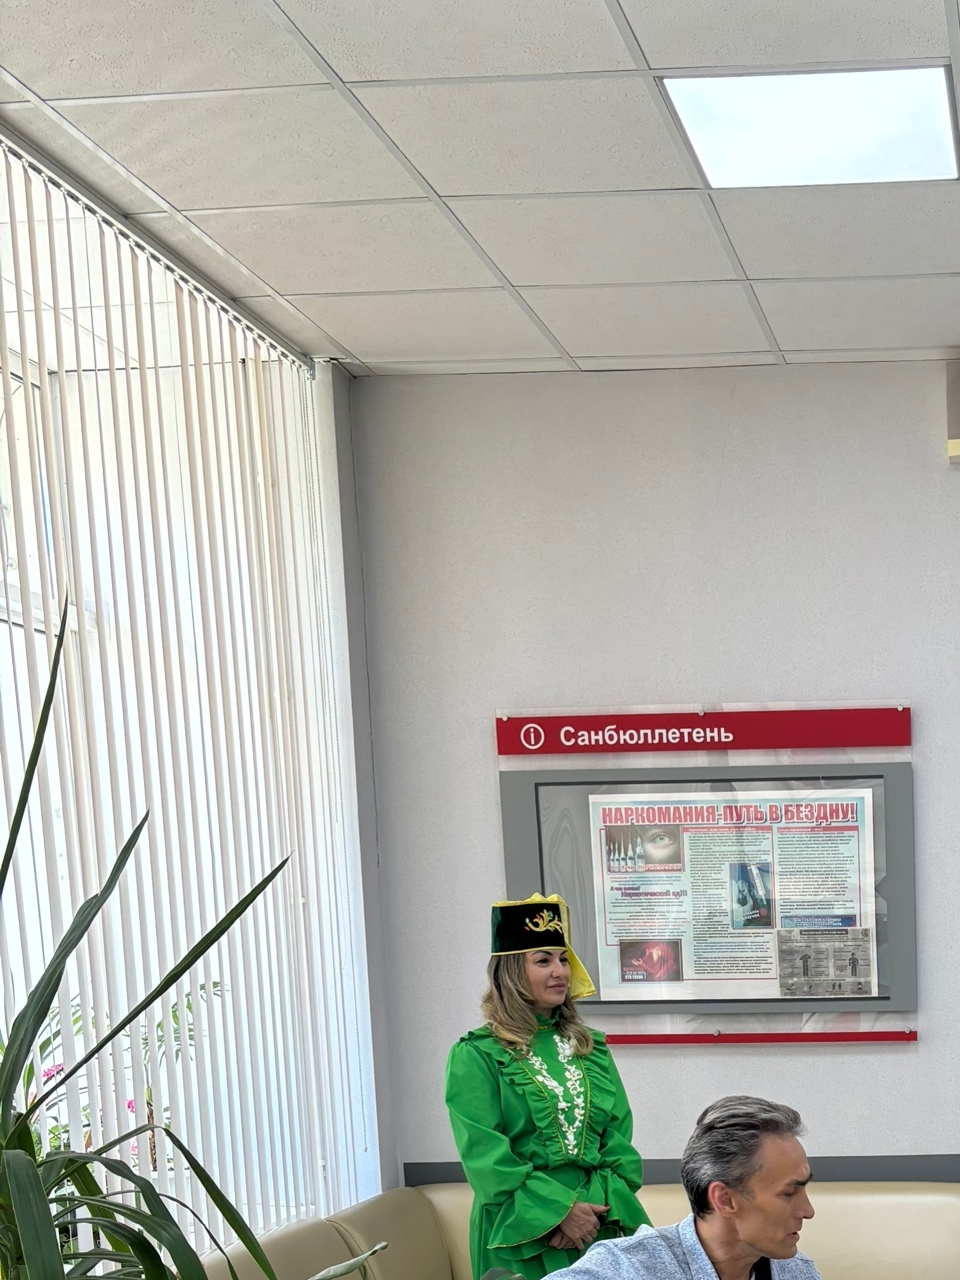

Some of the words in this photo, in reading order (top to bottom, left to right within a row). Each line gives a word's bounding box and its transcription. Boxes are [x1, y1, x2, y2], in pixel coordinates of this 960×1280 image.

[560, 725, 734, 746] Санбюллетень
[769, 803, 780, 823] В
[783, 802, 856, 825] БЕЗДНУ!
